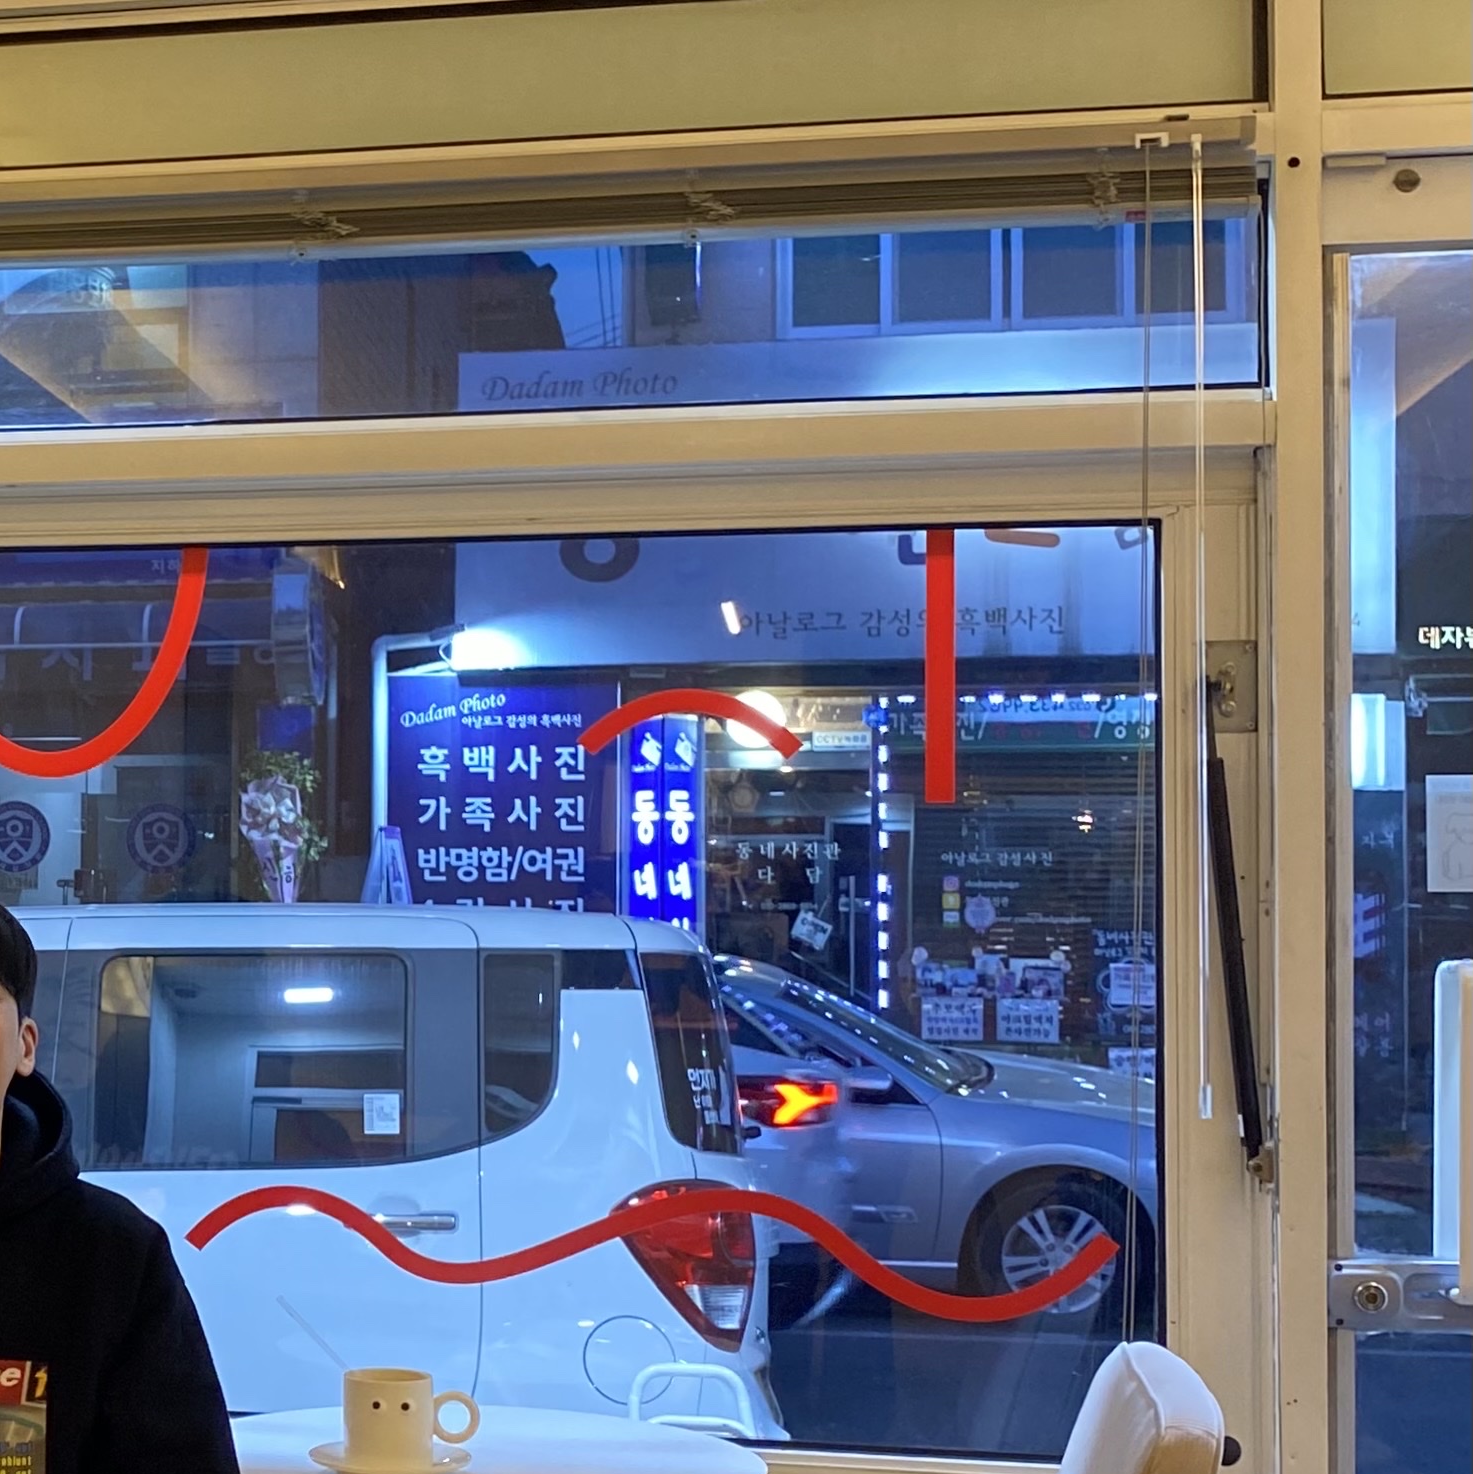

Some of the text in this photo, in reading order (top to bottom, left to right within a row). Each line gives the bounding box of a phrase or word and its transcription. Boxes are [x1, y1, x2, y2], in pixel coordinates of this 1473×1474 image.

[481, 367, 679, 401] Dadam Photo
[740, 609, 847, 640] 아날로그
[955, 605, 1067, 634] 흑백사진
[400, 693, 507, 728] Dadam Photo
[461, 714, 504, 729] 아날로그
[539, 713, 583, 727] 흑백사진
[417, 744, 586, 783] 흑백사진
[417, 795, 586, 833] 가족사진
[417, 846, 586, 883] 반명함/여권
[631, 789, 660, 920] 동네
[736, 841, 842, 861] 동네사진관
